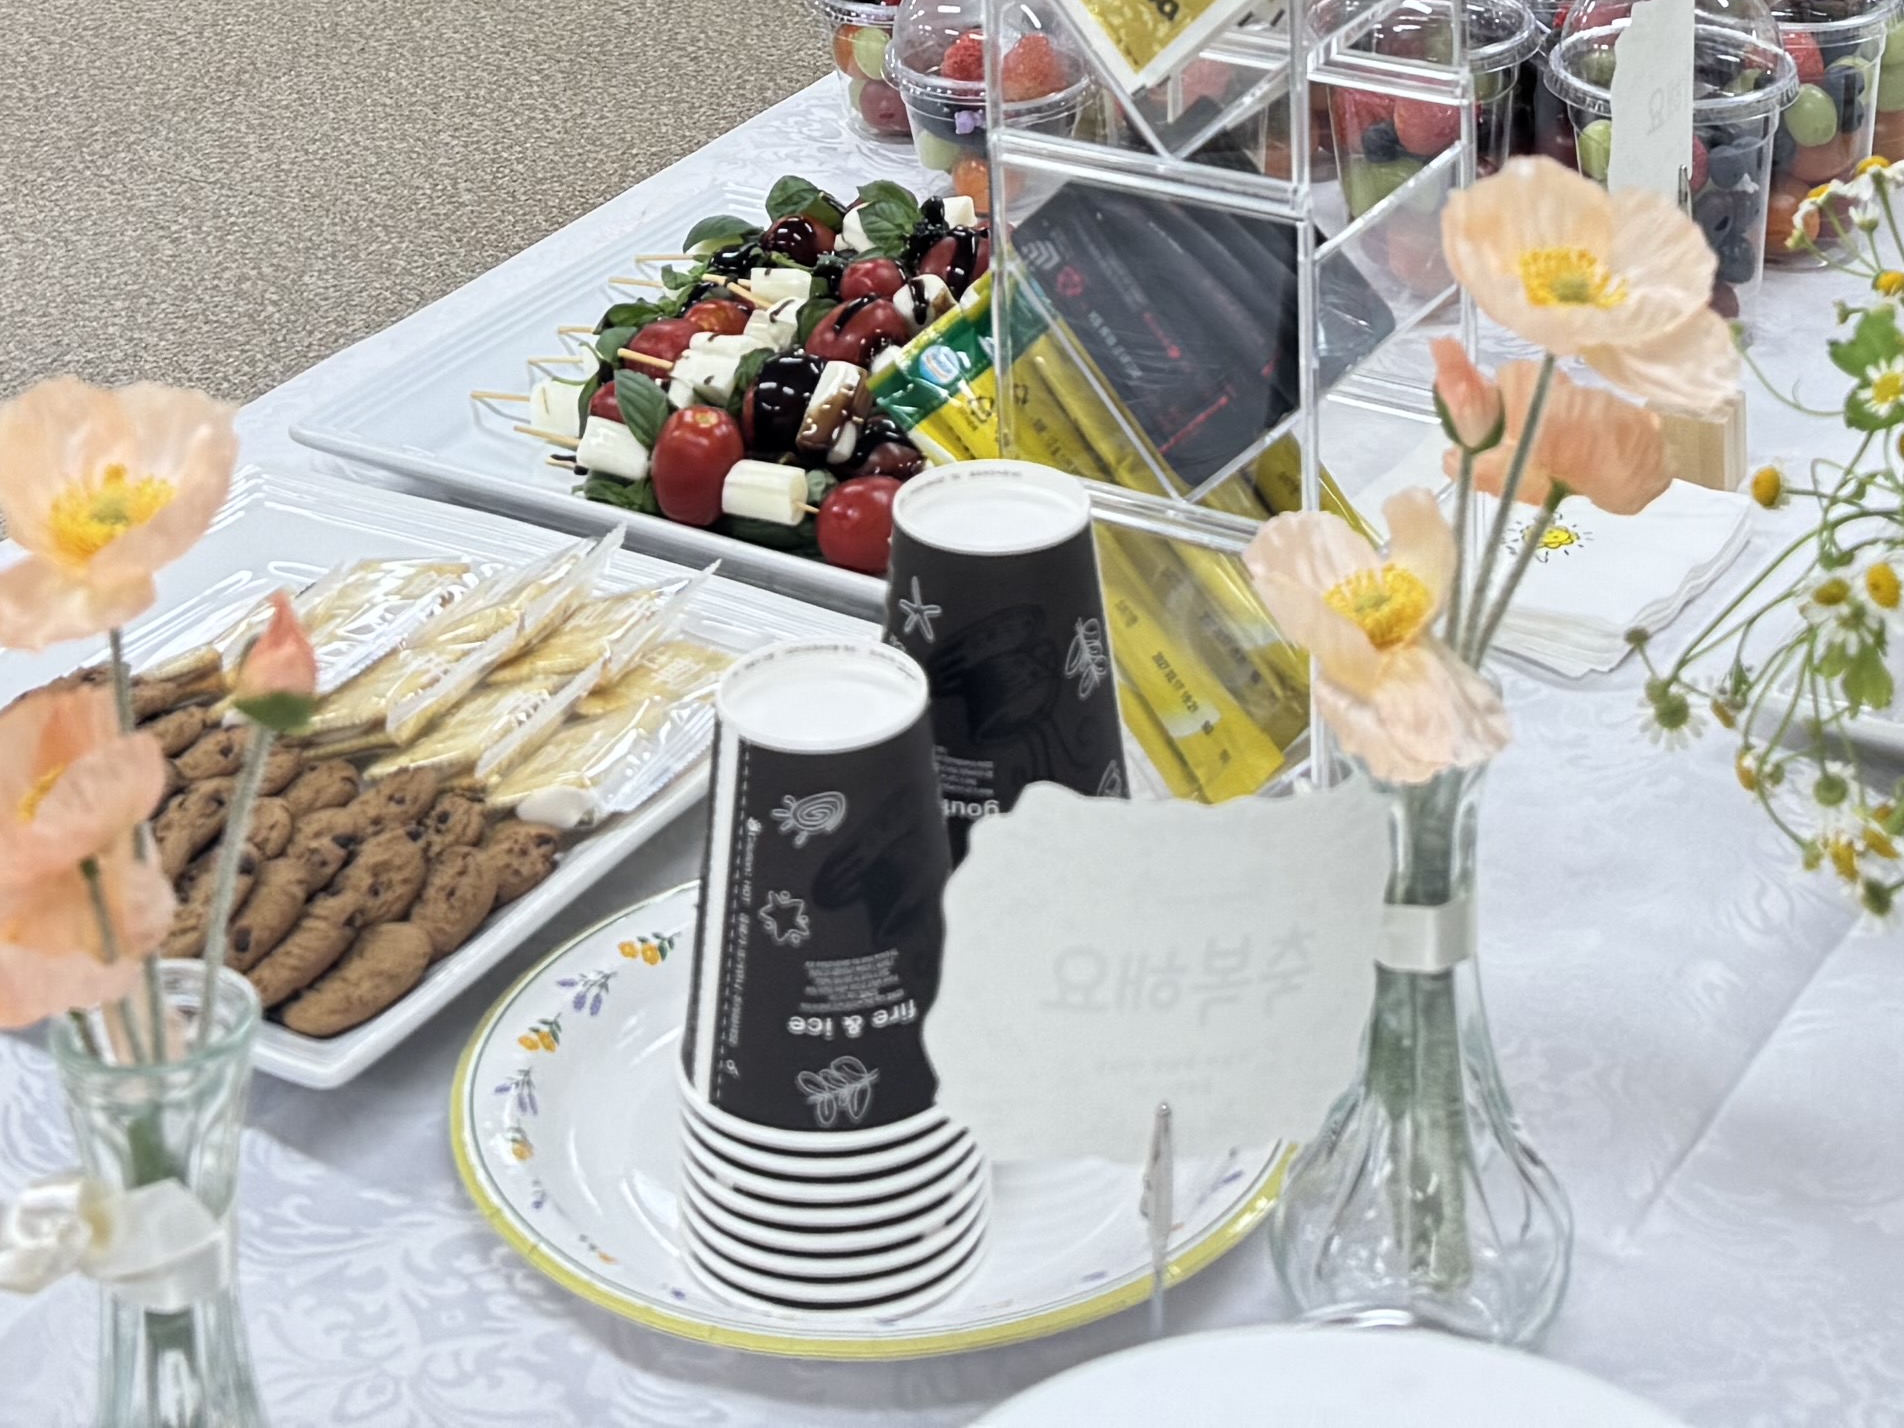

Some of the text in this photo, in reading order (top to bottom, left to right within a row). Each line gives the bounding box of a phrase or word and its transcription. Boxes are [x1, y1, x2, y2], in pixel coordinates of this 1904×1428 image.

[787, 998, 918, 1040] fire & ice
